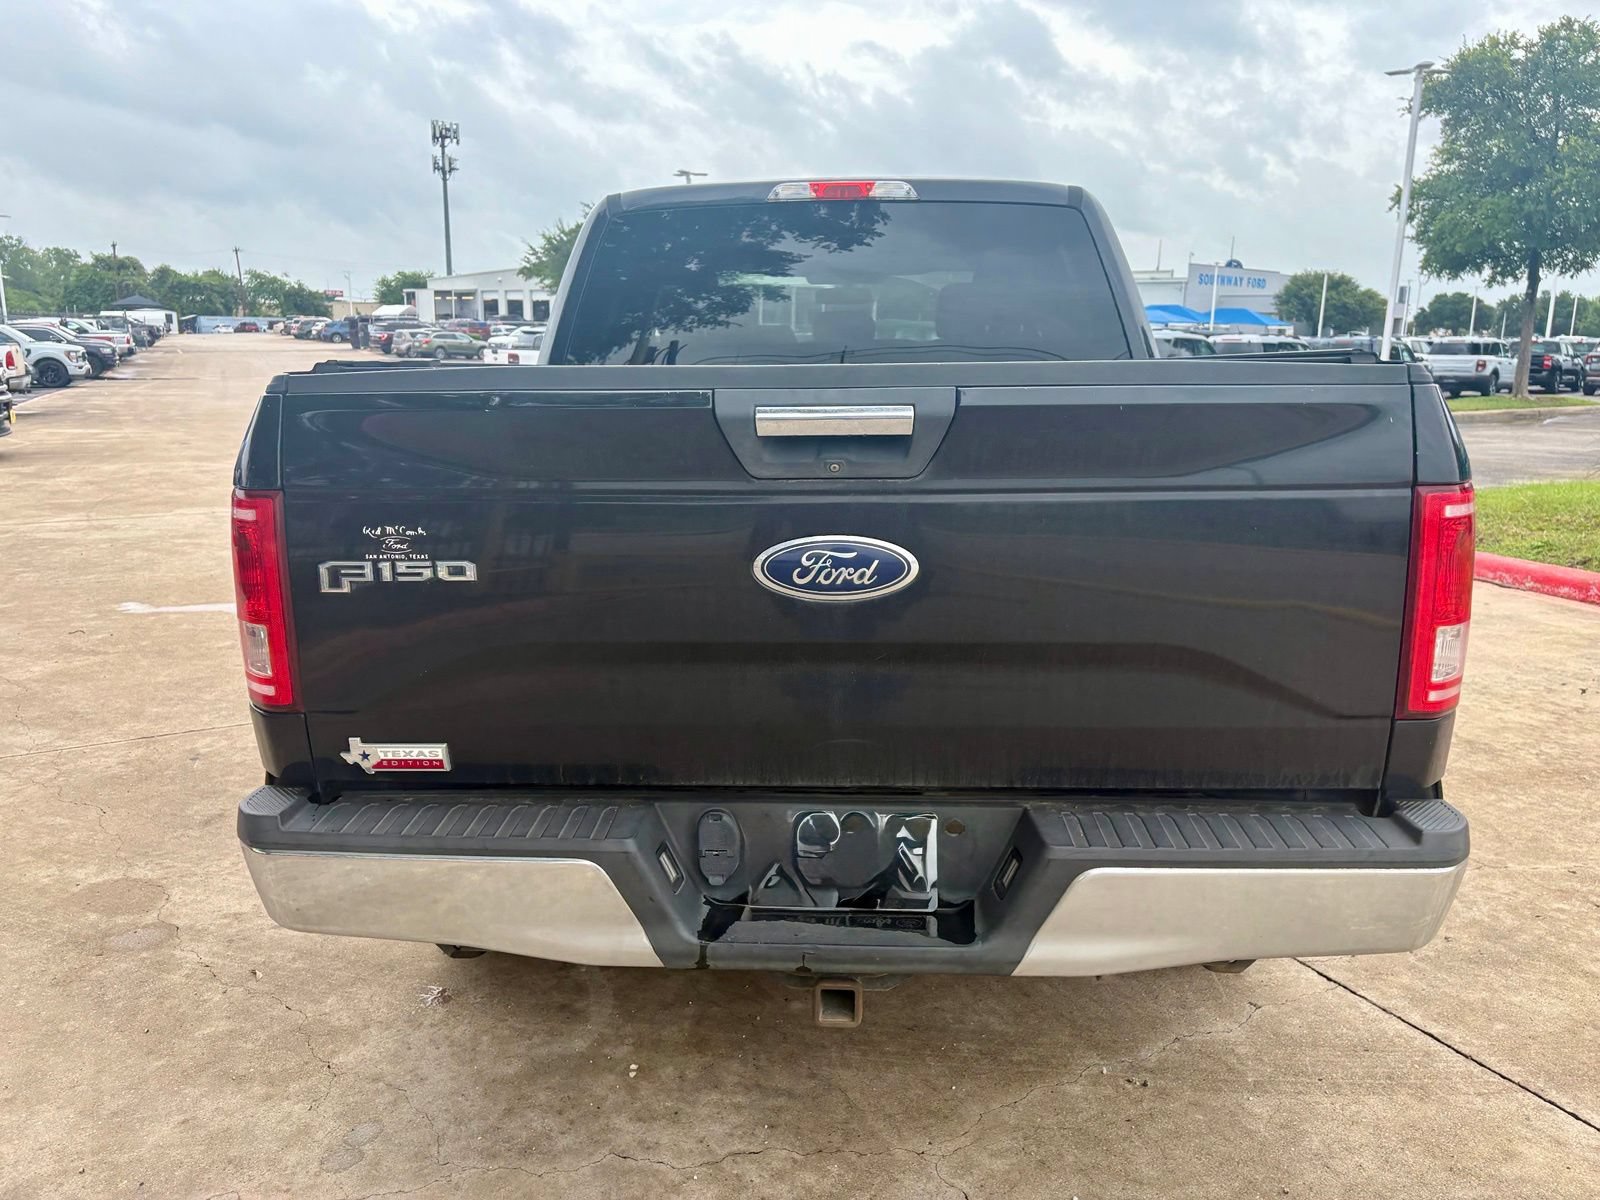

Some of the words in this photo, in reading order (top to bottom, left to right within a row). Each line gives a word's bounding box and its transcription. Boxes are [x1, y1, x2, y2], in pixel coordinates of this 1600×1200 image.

[1198, 273, 1244, 287] SOUTHWAY
[1247, 277, 1267, 289] FORD
[382, 538, 409, 550] Ford
[379, 553, 408, 561] ANTONIO,
[792, 549, 880, 585] Ford
[379, 750, 440, 758] TEXAS
